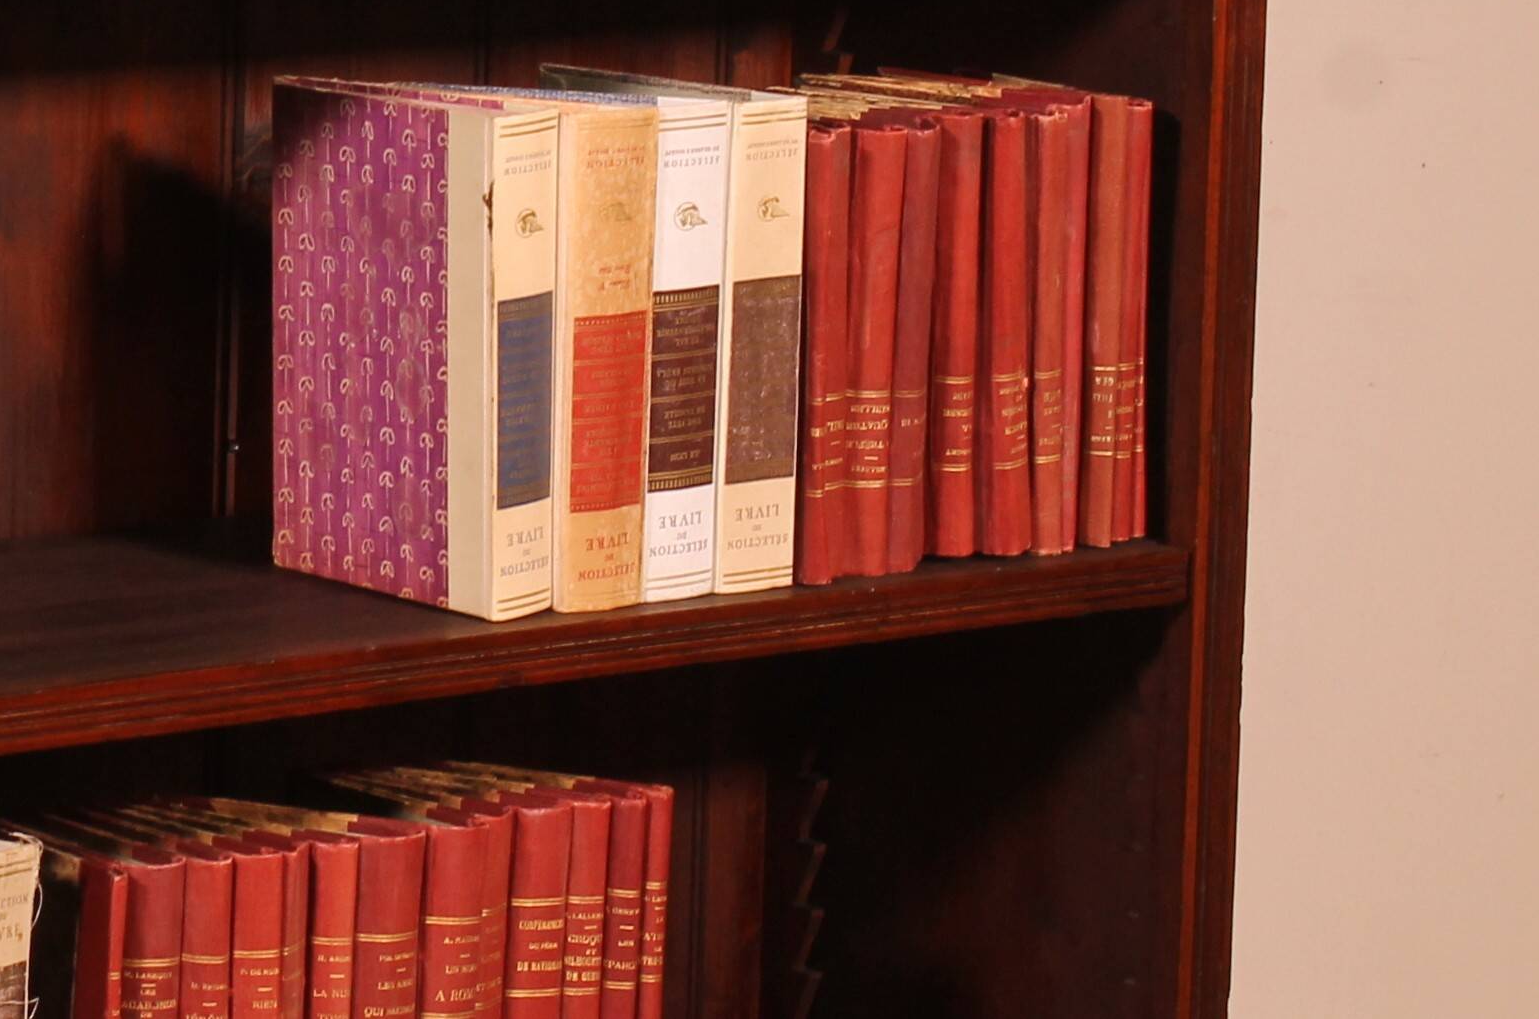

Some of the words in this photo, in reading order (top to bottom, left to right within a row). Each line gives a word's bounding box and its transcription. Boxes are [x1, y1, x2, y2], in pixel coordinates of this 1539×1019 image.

[658, 510, 702, 530] LIVRE
[734, 502, 780, 522] LIVRE
[507, 526, 544, 547] LIVRE
[585, 531, 629, 551] LIVRE
[313, 988, 327, 998] LA
[435, 989, 446, 1002] A
[363, 1005, 384, 1018] QUI
